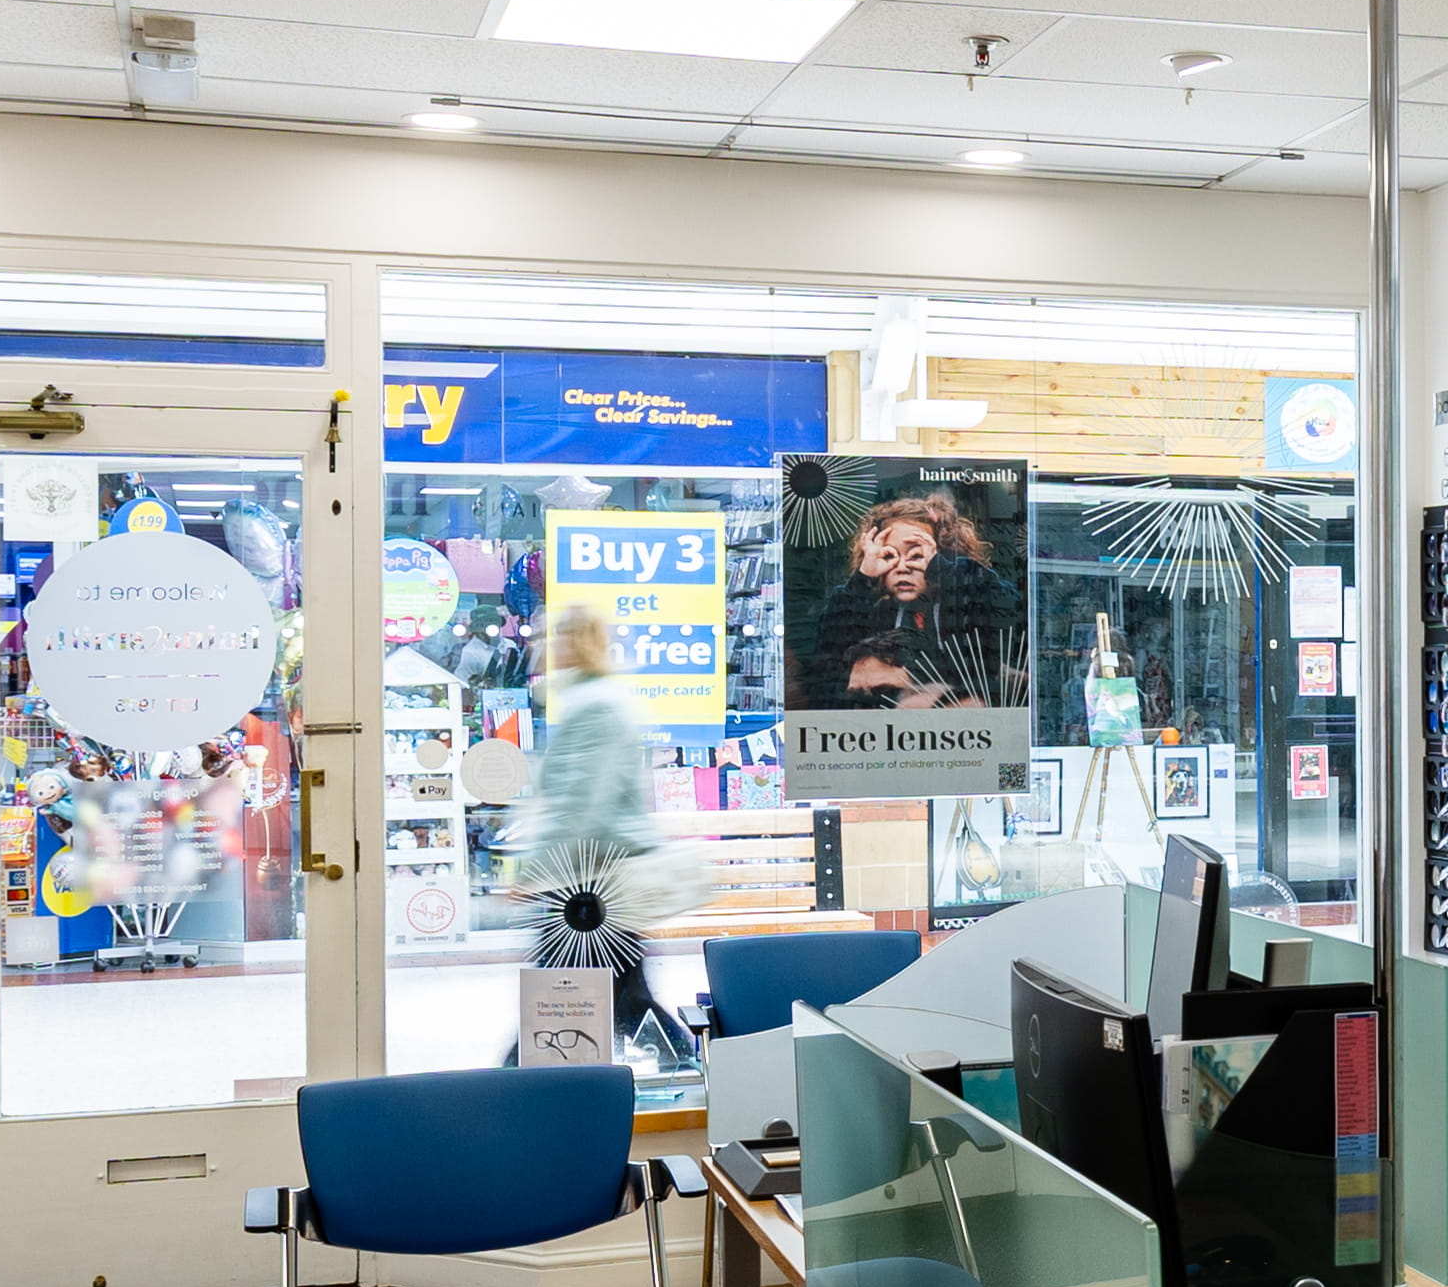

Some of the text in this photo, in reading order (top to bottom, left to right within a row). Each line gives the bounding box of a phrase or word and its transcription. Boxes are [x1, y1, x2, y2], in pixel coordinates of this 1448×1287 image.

[564, 388, 686, 408] Clear Prices...
[595, 407, 733, 429] Clear Savings...
[919, 466, 1018, 486] haine&smith
[132, 514, 163, 528] £1.99
[411, 549, 430, 570] Pig
[570, 533, 705, 583] Buy 3
[616, 593, 659, 617] get
[634, 634, 712, 665] free
[797, 726, 876, 754] Free
[885, 723, 993, 753] lenses
[796, 762, 817, 772] with
[818, 763, 826, 771] a
[828, 760, 864, 771] second
[866, 760, 885, 772] pair
[887, 760, 898, 770] of
[899, 759, 945, 770] children's
[427, 785, 447, 796] Pay
[536, 1001, 549, 1009] The
[567, 1001, 596, 1009] invisible
[537, 1010, 565, 1018] hearing
